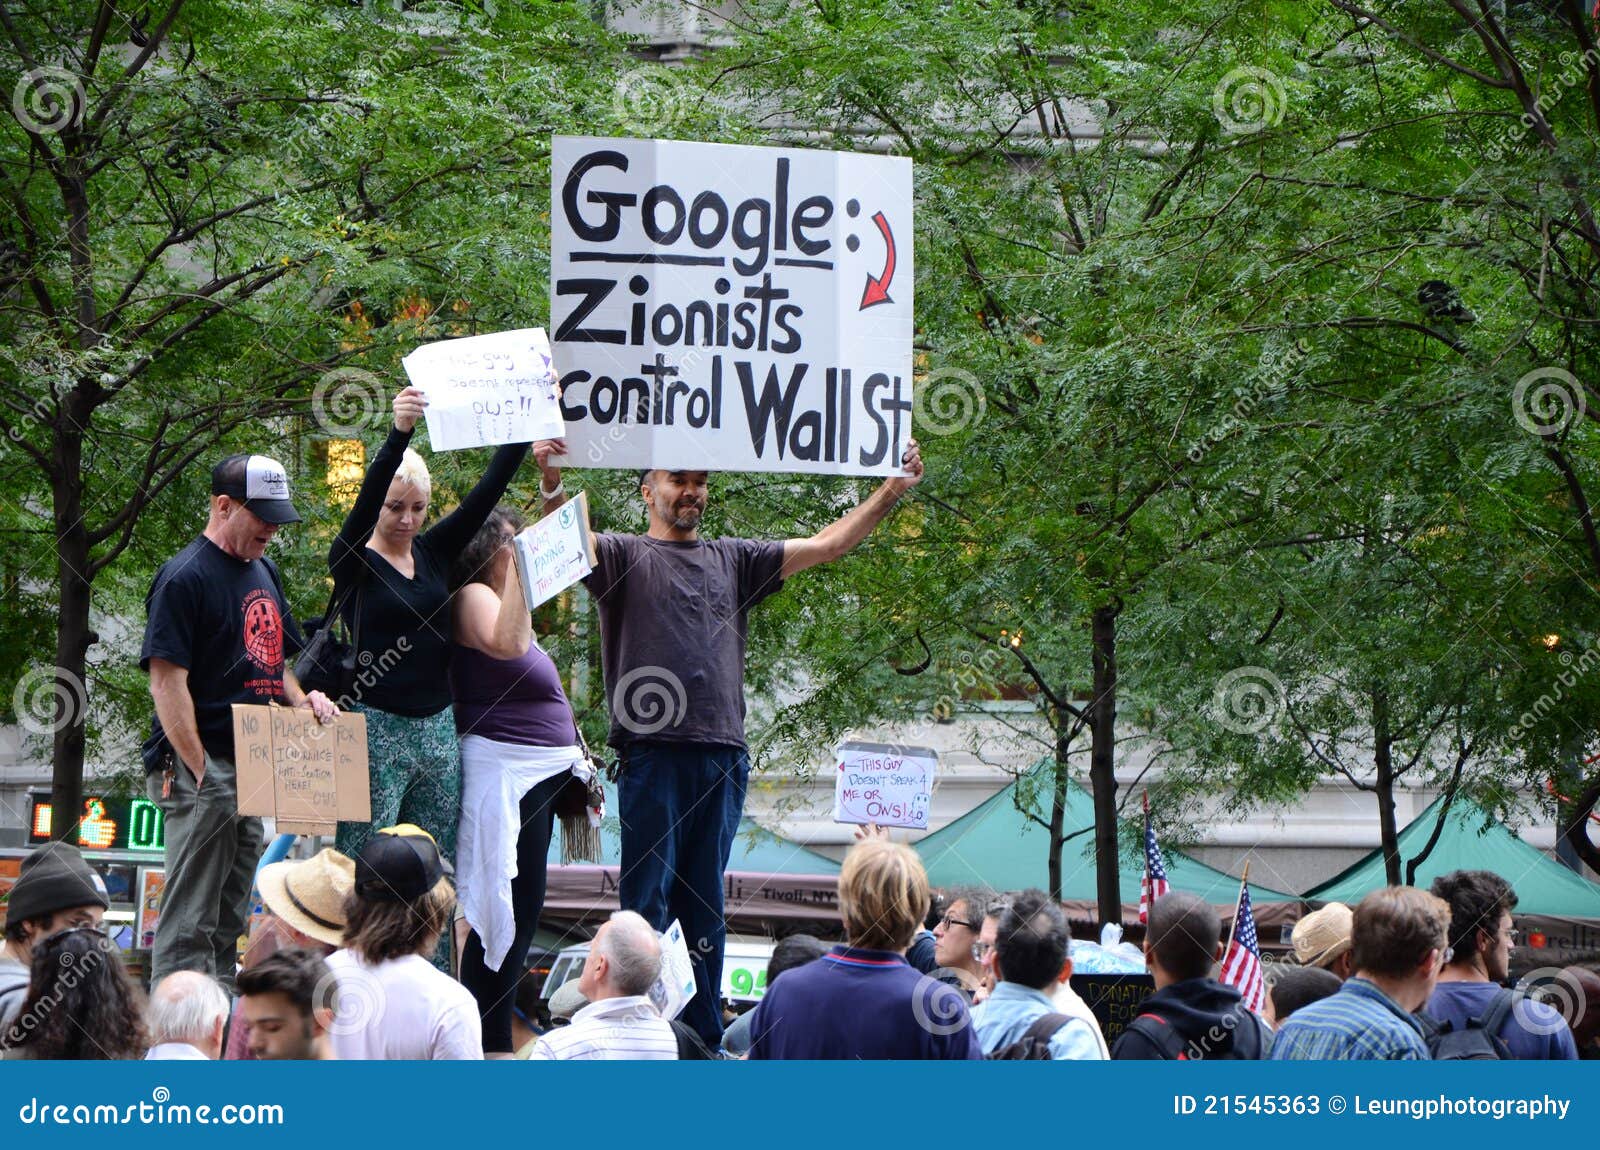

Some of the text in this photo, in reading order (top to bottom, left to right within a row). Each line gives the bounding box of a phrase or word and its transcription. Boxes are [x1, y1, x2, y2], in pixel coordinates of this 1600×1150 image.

[555, 273, 804, 354] Zionists
[558, 353, 722, 429] control
[734, 361, 852, 463] Wall
[241, 714, 259, 738] NO
[249, 743, 269, 763] FOR
[859, 757, 904, 773] THIS GUY
[890, 773, 918, 786] SPEAK
[843, 788, 883, 802] ME OR
[762, 887, 838, 902] Tivoli, NY
